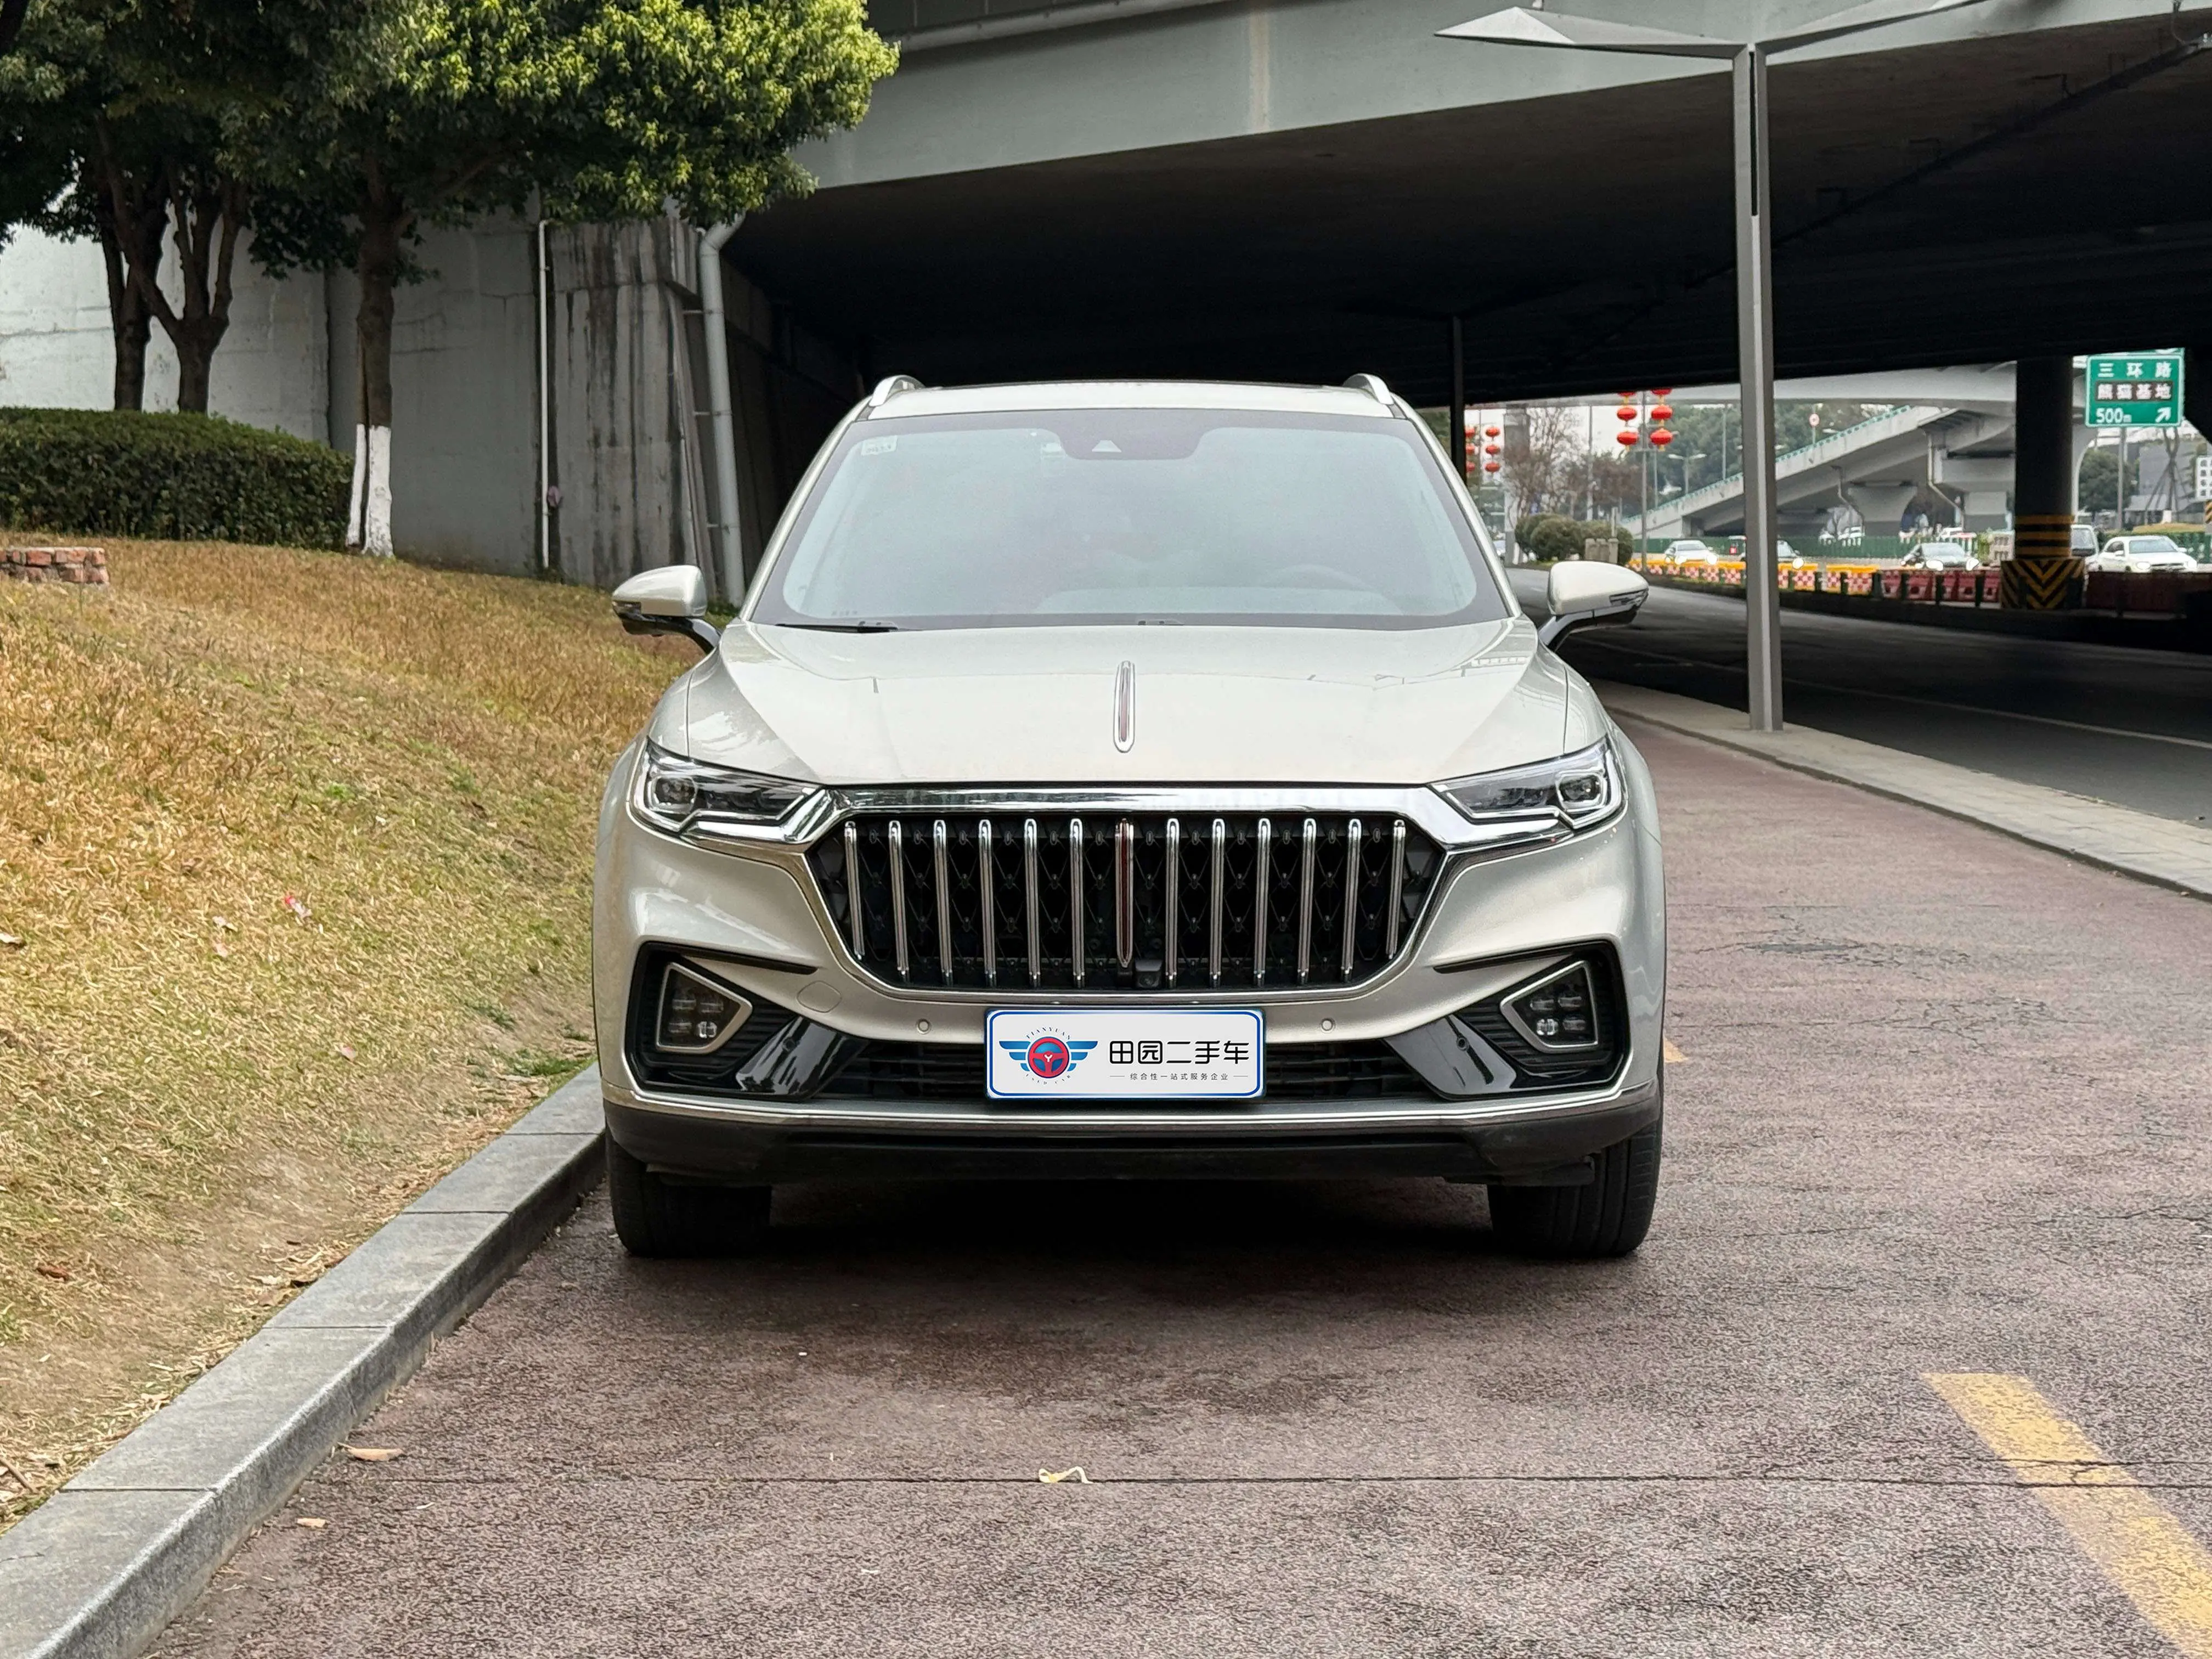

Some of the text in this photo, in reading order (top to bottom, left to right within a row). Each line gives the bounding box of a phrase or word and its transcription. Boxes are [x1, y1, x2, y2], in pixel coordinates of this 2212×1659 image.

[2097, 362, 2172, 378] 三环路
[2096, 408, 2132, 423] 500m
[1109, 1040, 1249, 1064] 田园二手车
